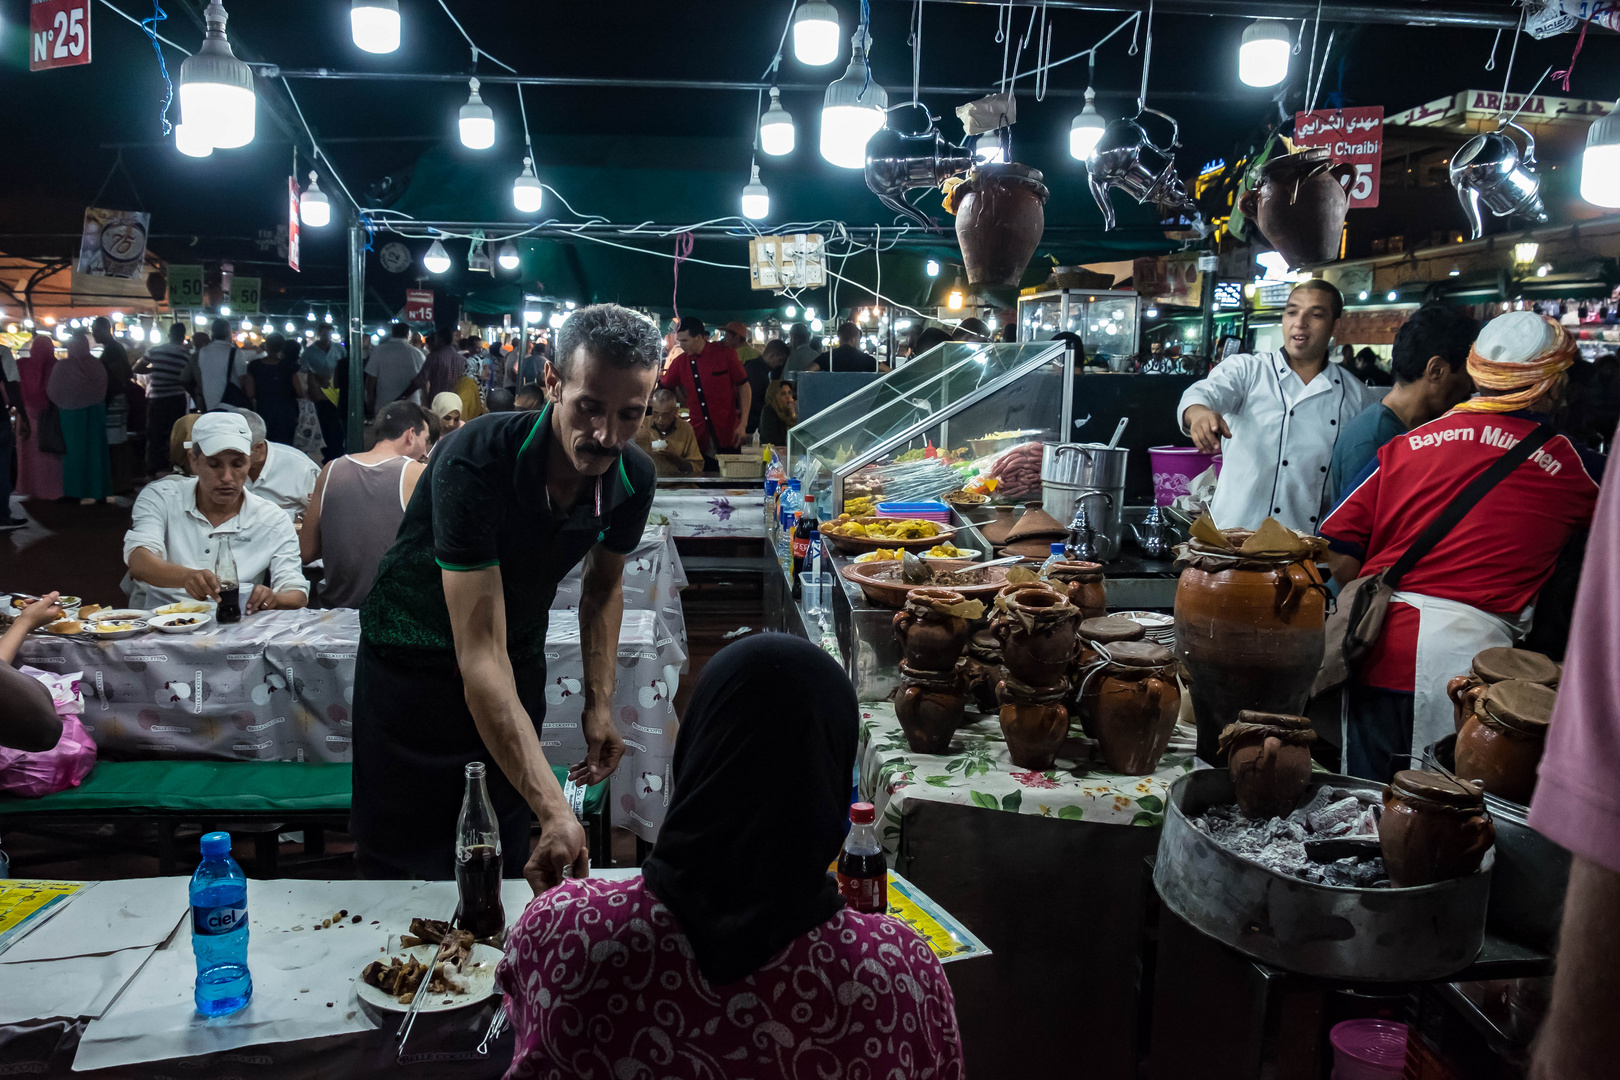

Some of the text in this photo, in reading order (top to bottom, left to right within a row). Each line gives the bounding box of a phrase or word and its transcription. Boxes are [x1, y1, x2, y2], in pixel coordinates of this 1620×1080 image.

[1346, 117, 1380, 134] مهدي
[1334, 140, 1379, 156] Chraibi
[182, 280, 202, 295] 50
[241, 289, 260, 304] 50
[1409, 425, 1562, 476] Bayern Münhen
[208, 909, 236, 927] ciel
